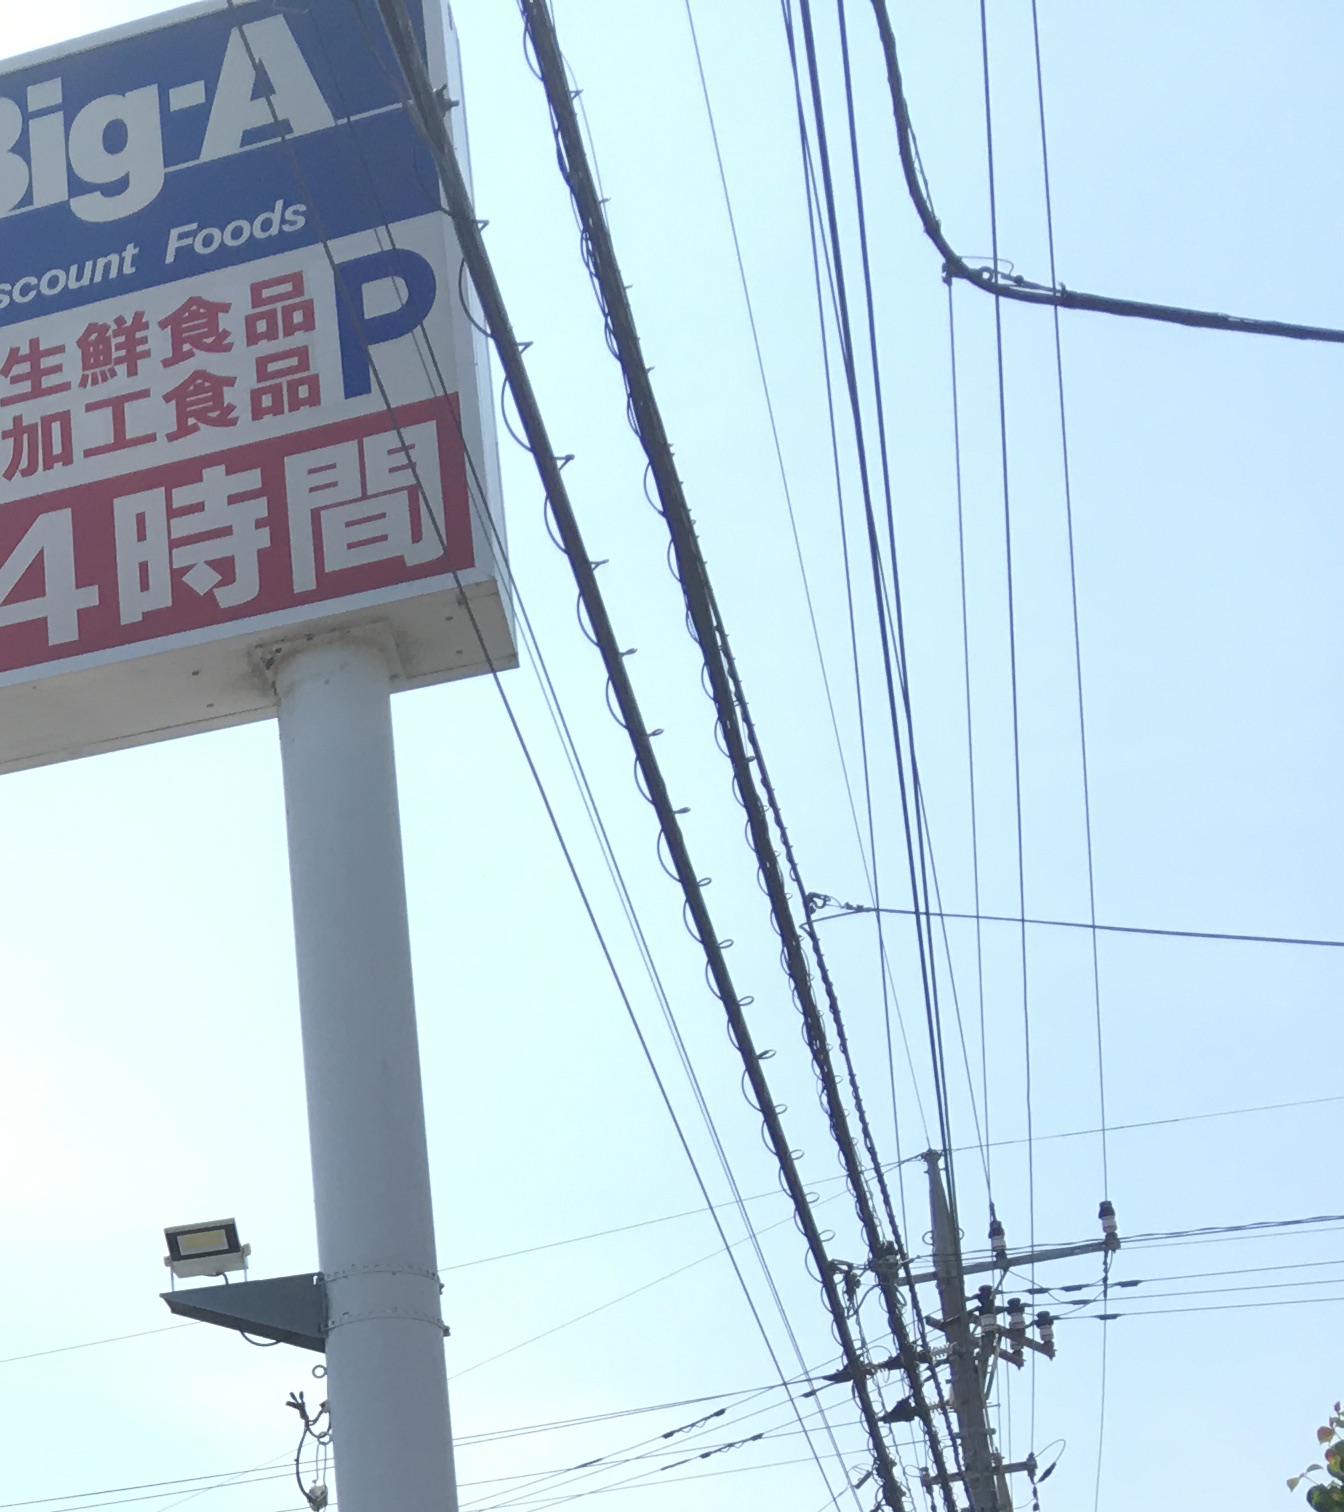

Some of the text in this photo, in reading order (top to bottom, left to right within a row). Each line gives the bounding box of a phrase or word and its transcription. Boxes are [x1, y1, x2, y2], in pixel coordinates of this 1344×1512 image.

[164, 198, 308, 265] Foods
[1, 345, 322, 483] 加工食品
